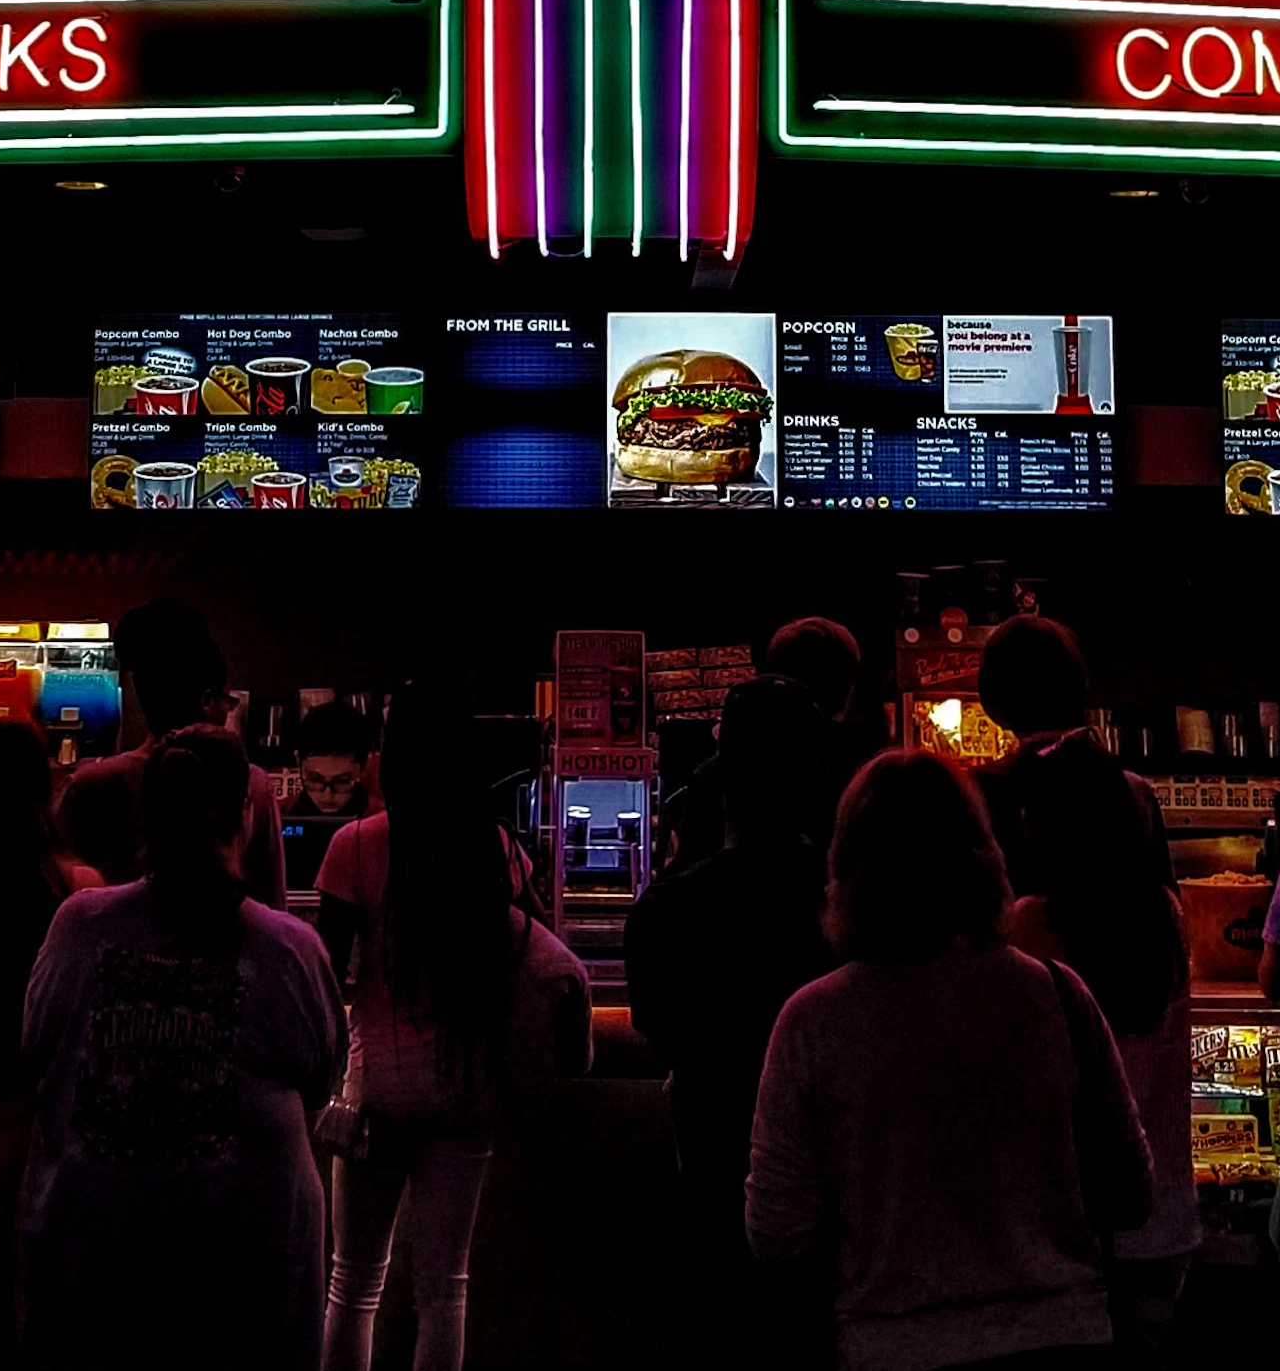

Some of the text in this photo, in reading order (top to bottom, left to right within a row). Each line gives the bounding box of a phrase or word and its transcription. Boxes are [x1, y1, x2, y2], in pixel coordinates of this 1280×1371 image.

[446, 319, 571, 331] FROM THE GRILL
[782, 322, 856, 334] POPCORN
[947, 320, 991, 329] because
[95, 329, 180, 340] Popcorn Combo
[207, 329, 292, 341] Hot Dog Combo
[319, 328, 398, 338] Nachos Combo
[948, 332, 967, 341] you
[970, 332, 1008, 341] belong
[1222, 335, 1266, 346] Popcorn
[948, 343, 1032, 352] movie premiere
[783, 415, 839, 427] DRINKS
[916, 417, 977, 429] SNACKS
[92, 423, 170, 433] Pretzel Combo
[204, 422, 277, 433] Triple Combo
[317, 422, 384, 432] Kid's Combo
[1224, 429, 1264, 440] Pretzel
[1214, 1061, 1235, 1073] 5.25
